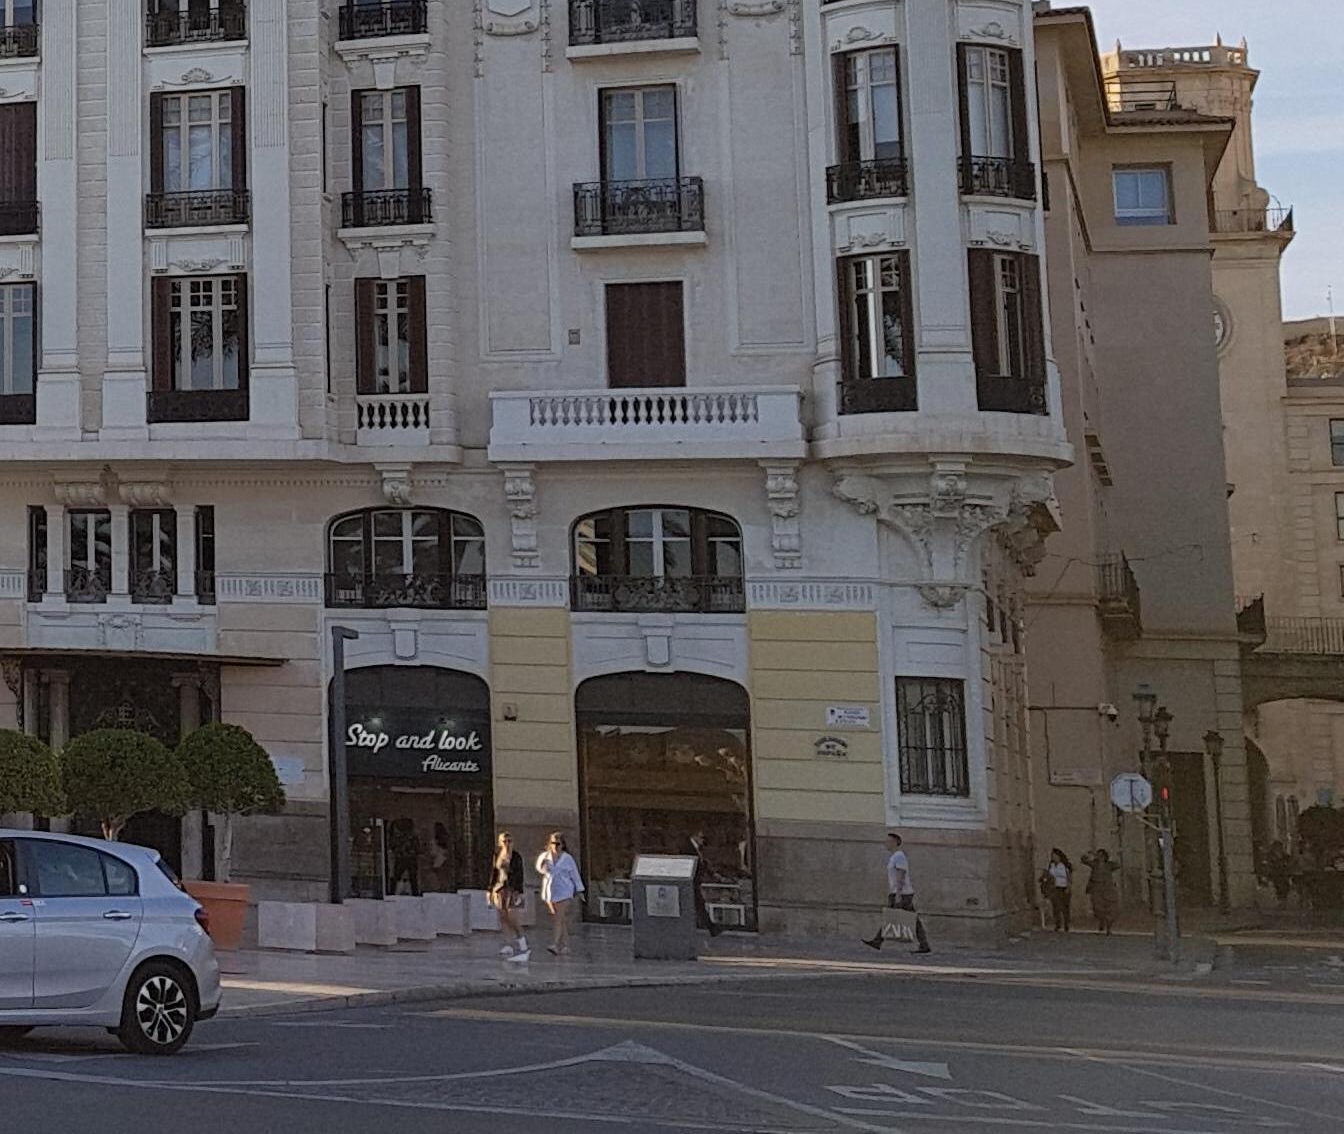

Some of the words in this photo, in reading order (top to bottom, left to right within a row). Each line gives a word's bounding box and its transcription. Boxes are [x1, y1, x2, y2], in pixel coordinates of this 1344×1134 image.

[345, 723, 389, 753] Stop
[395, 730, 436, 749] and
[438, 730, 482, 750] look
[422, 755, 480, 772] Alicante
